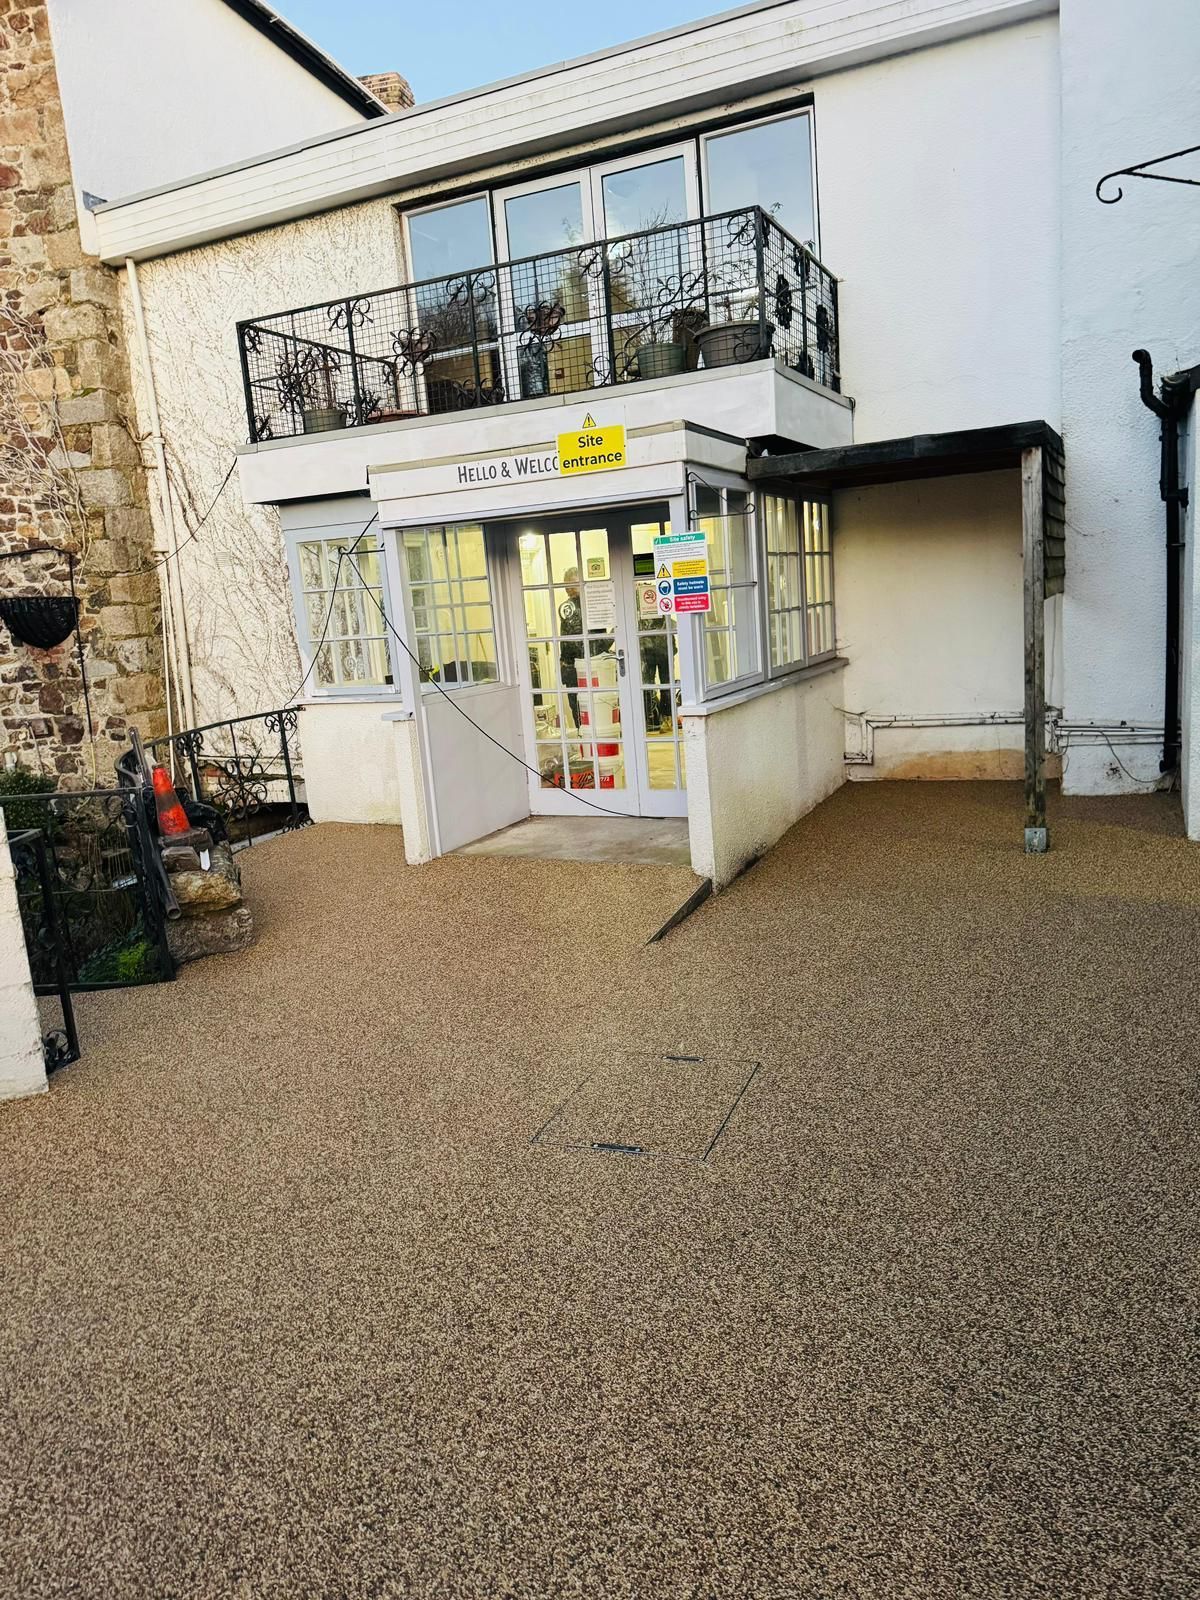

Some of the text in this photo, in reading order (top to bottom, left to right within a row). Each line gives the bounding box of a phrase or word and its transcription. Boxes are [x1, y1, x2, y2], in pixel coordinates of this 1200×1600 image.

[578, 434, 603, 448] Site
[563, 451, 622, 469] entrance
[457, 456, 558, 483] HELLO & WELCO
